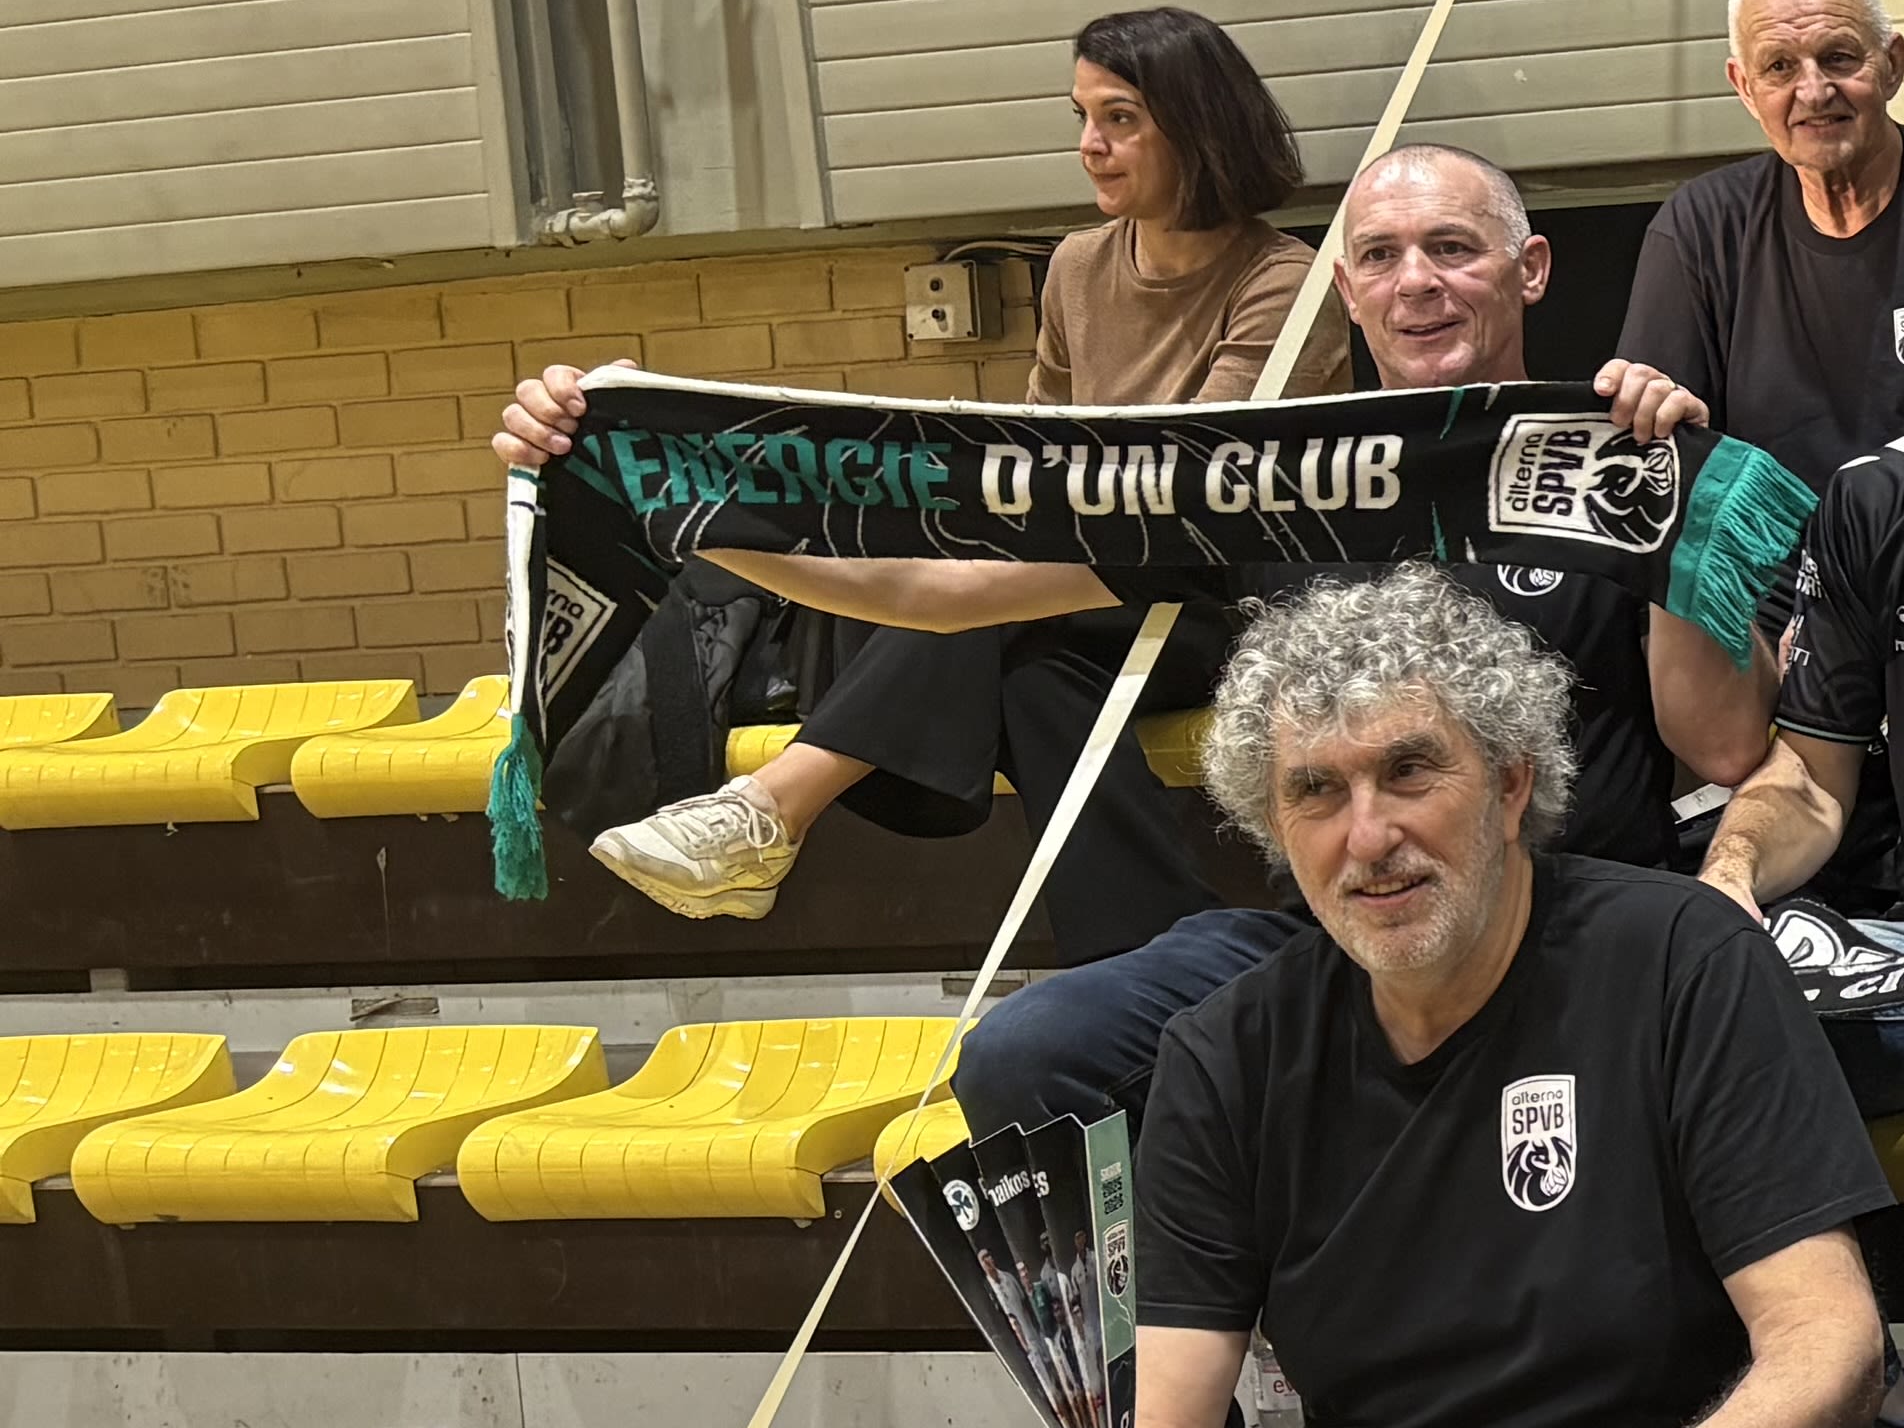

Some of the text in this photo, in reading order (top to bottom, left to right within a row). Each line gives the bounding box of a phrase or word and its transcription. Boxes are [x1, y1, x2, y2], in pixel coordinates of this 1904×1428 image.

[981, 443, 1179, 516] D'UN
[1205, 435, 1403, 514] CLUB
[1532, 430, 1591, 516] SPVB
[1512, 1103, 1564, 1135] SPVB
